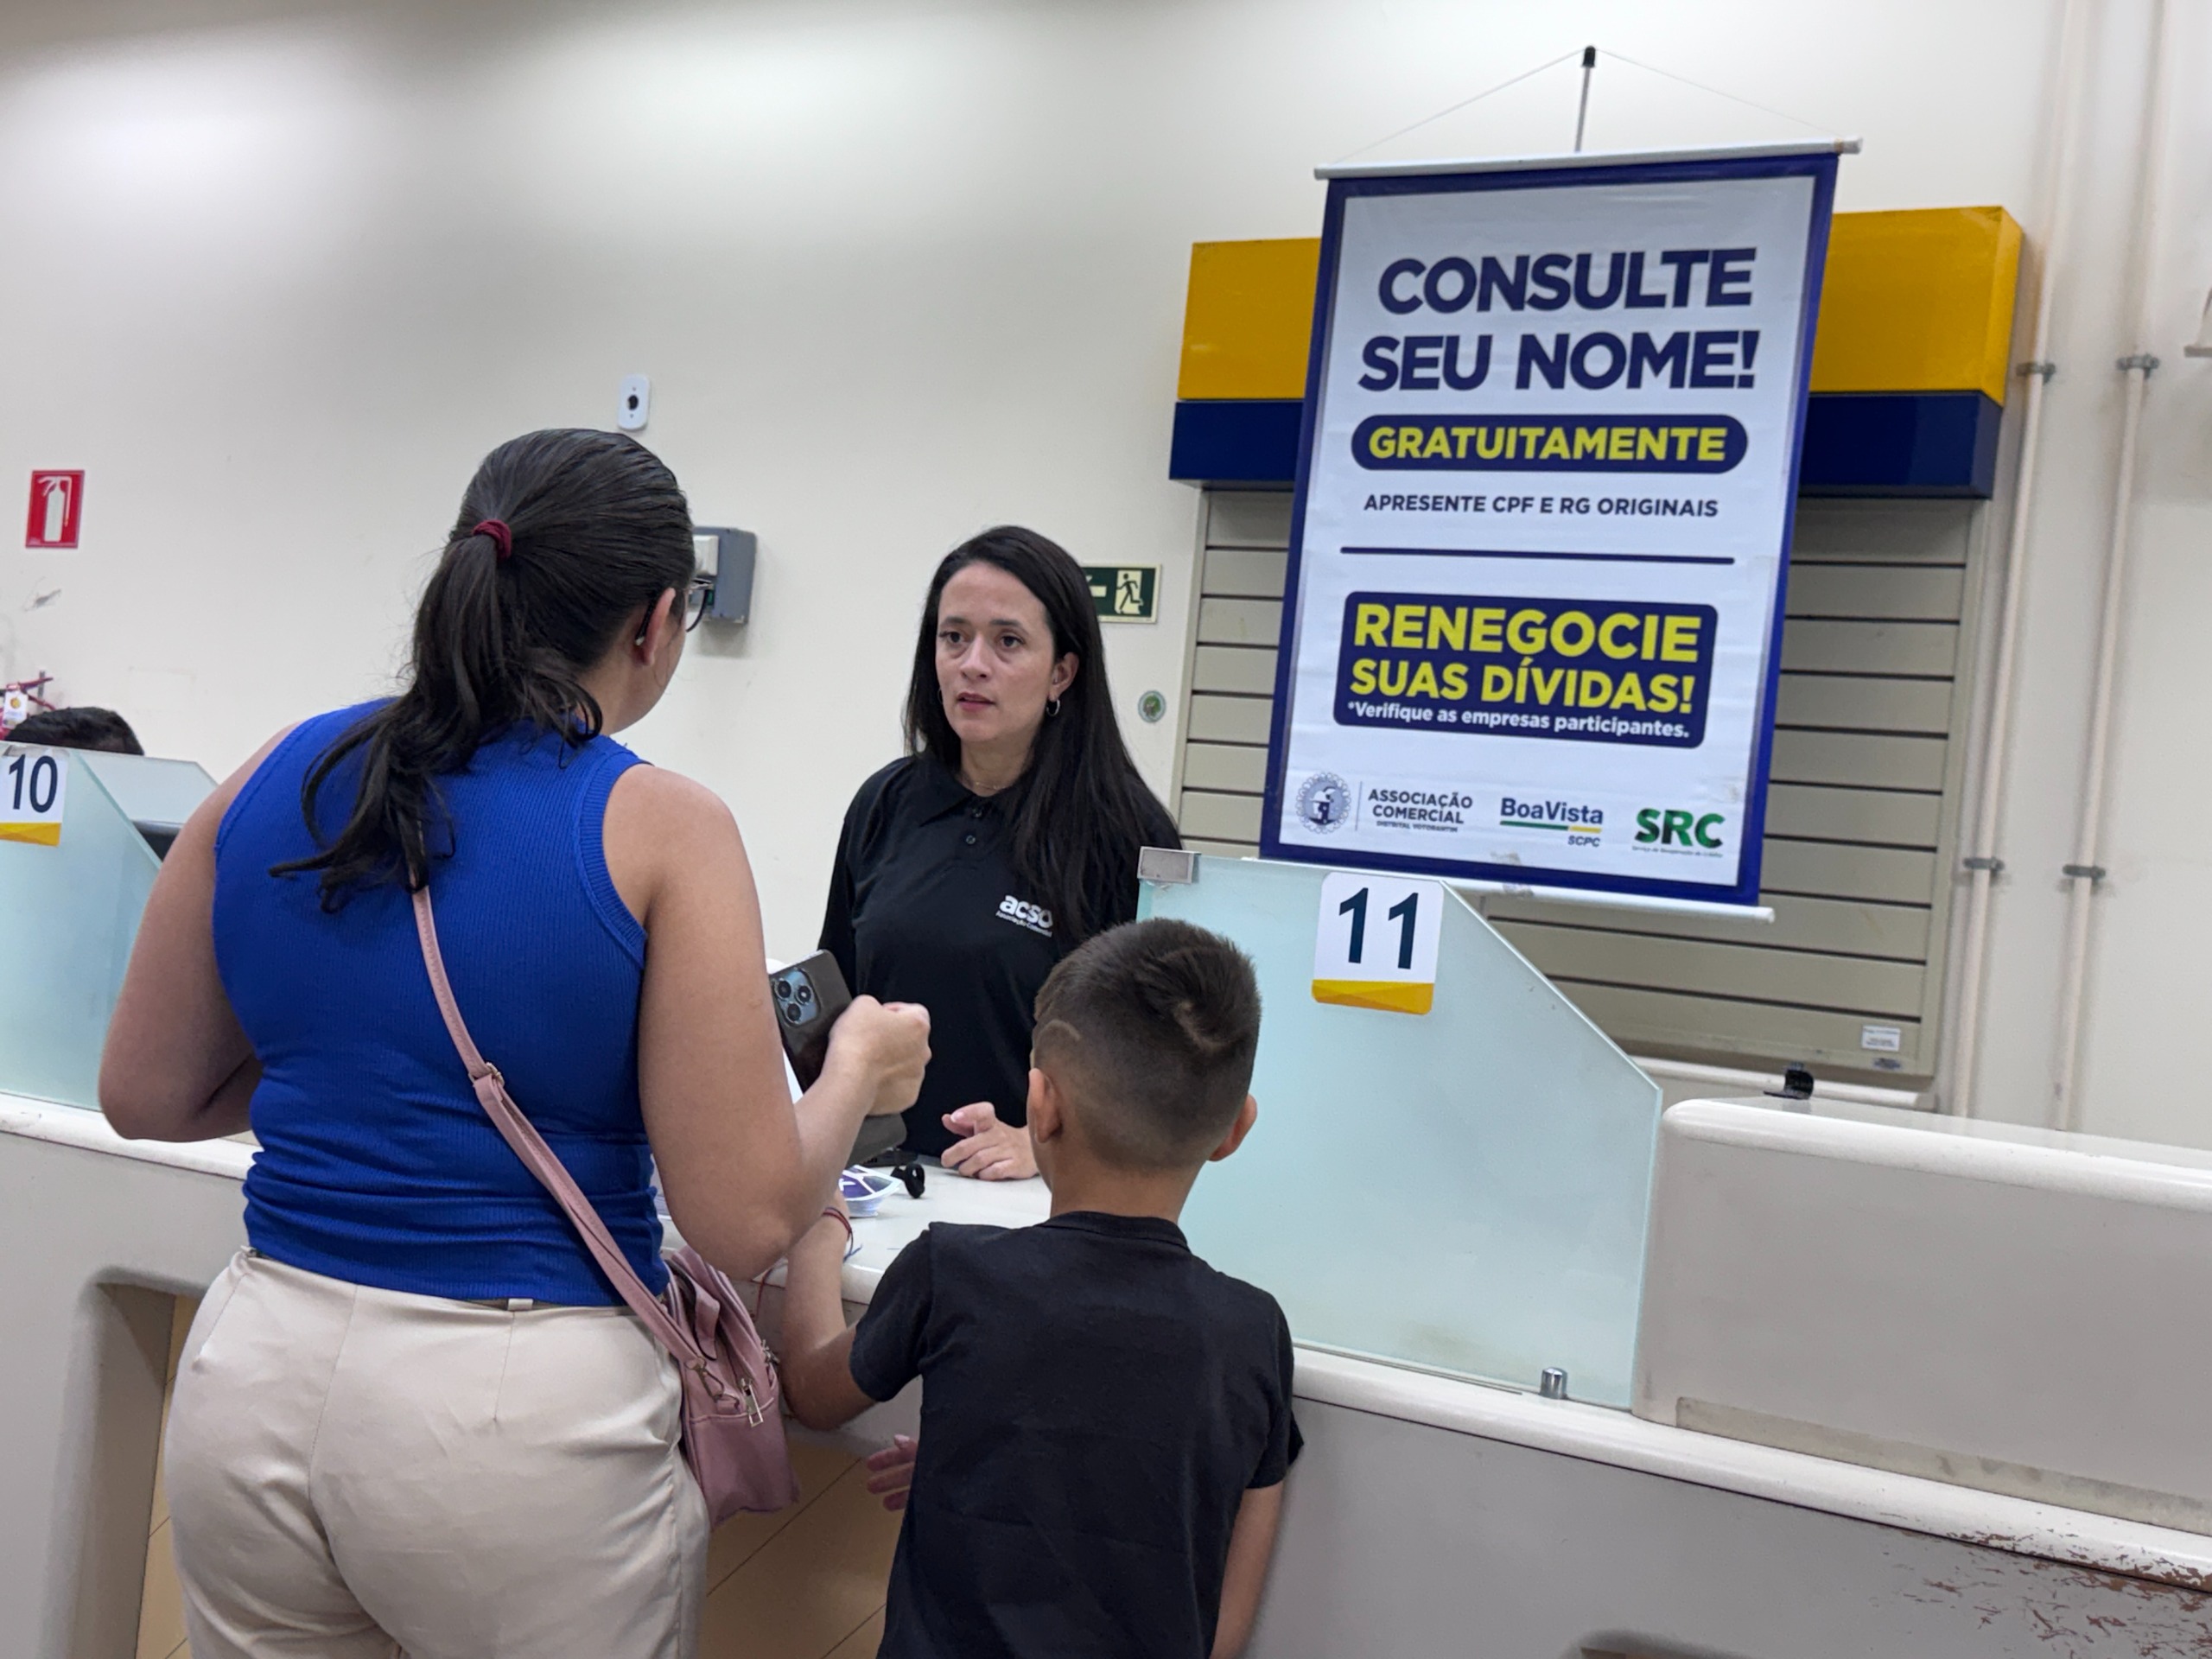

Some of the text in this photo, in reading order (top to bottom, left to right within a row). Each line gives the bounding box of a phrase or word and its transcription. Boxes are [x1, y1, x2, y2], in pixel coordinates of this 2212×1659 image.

[1378, 247, 1758, 315] CONSULTE
[1357, 329, 1760, 391] SEU NOME!
[1368, 426, 1729, 463] GRATUITAMENTE
[1363, 494, 1719, 518] APRESENTE CPF E RG ORIGINAIS
[1353, 603, 1702, 663] RENEGOCIE
[1350, 657, 1694, 715] SUAS DÍVIDAS!
[1437, 709, 1458, 722] as
[1461, 709, 1551, 728] empresas
[1554, 715, 1689, 738] participantes.
[9, 753, 58, 813] 10
[1368, 788, 1473, 810] ASSOCIAÇÃO
[1372, 804, 1465, 824] COMERCIAL
[1500, 798, 1604, 824] BoaVista
[1635, 808, 1726, 849] SRC
[1567, 835, 1601, 848] SCPC
[1338, 887, 1419, 970] 11
